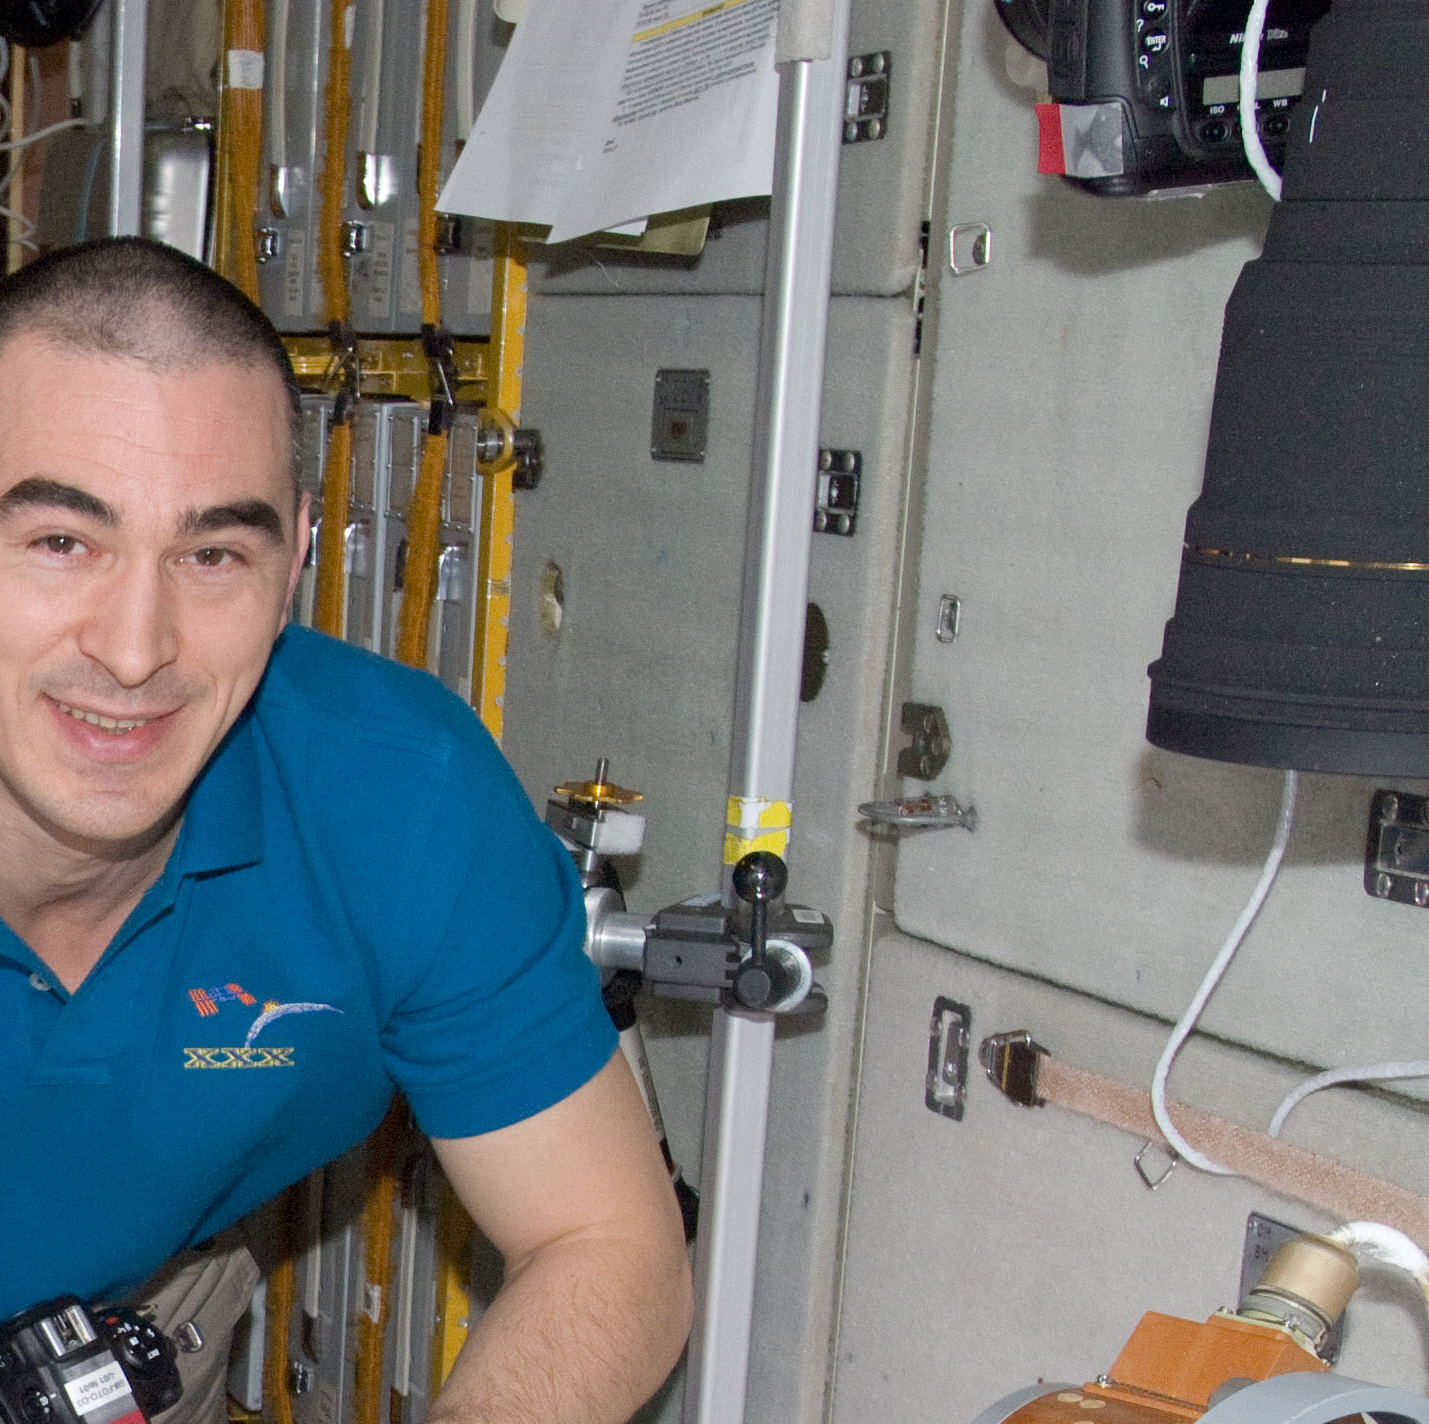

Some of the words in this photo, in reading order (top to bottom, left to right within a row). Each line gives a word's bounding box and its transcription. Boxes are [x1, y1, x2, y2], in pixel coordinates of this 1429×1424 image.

[1146, 35, 1167, 45] ENTER
[1273, 98, 1288, 107] WB
[1209, 105, 1225, 114] ISO
[184, 1047, 295, 1070] XXX
